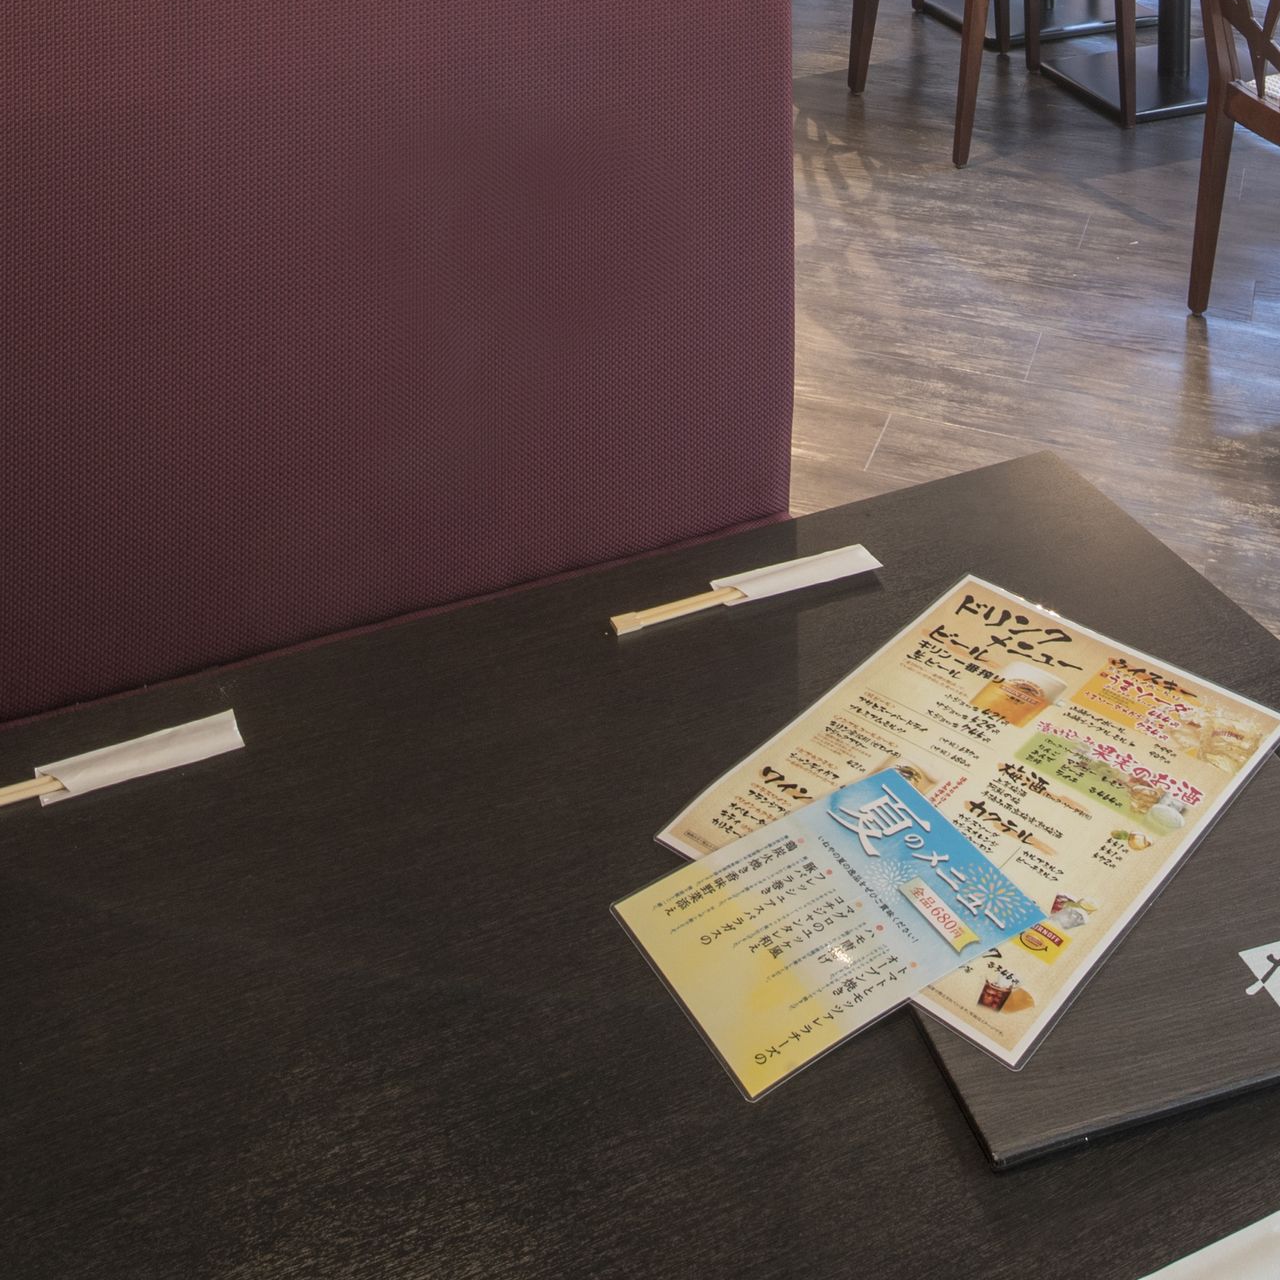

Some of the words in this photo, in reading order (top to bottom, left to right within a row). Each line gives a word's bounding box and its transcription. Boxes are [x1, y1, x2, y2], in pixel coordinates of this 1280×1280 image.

[955, 594, 1073, 645] ドリンク
[929, 624, 993, 663] ビール
[987, 633, 1083, 671] メニュー
[906, 649, 961, 679] 生ビール
[761, 766, 813, 800] ワイン
[998, 763, 1050, 795] 梅酒
[969, 800, 1033, 846] カクテル
[826, 783, 1006, 930] 夏のメニュー
[908, 886, 965, 939] 全品680円
